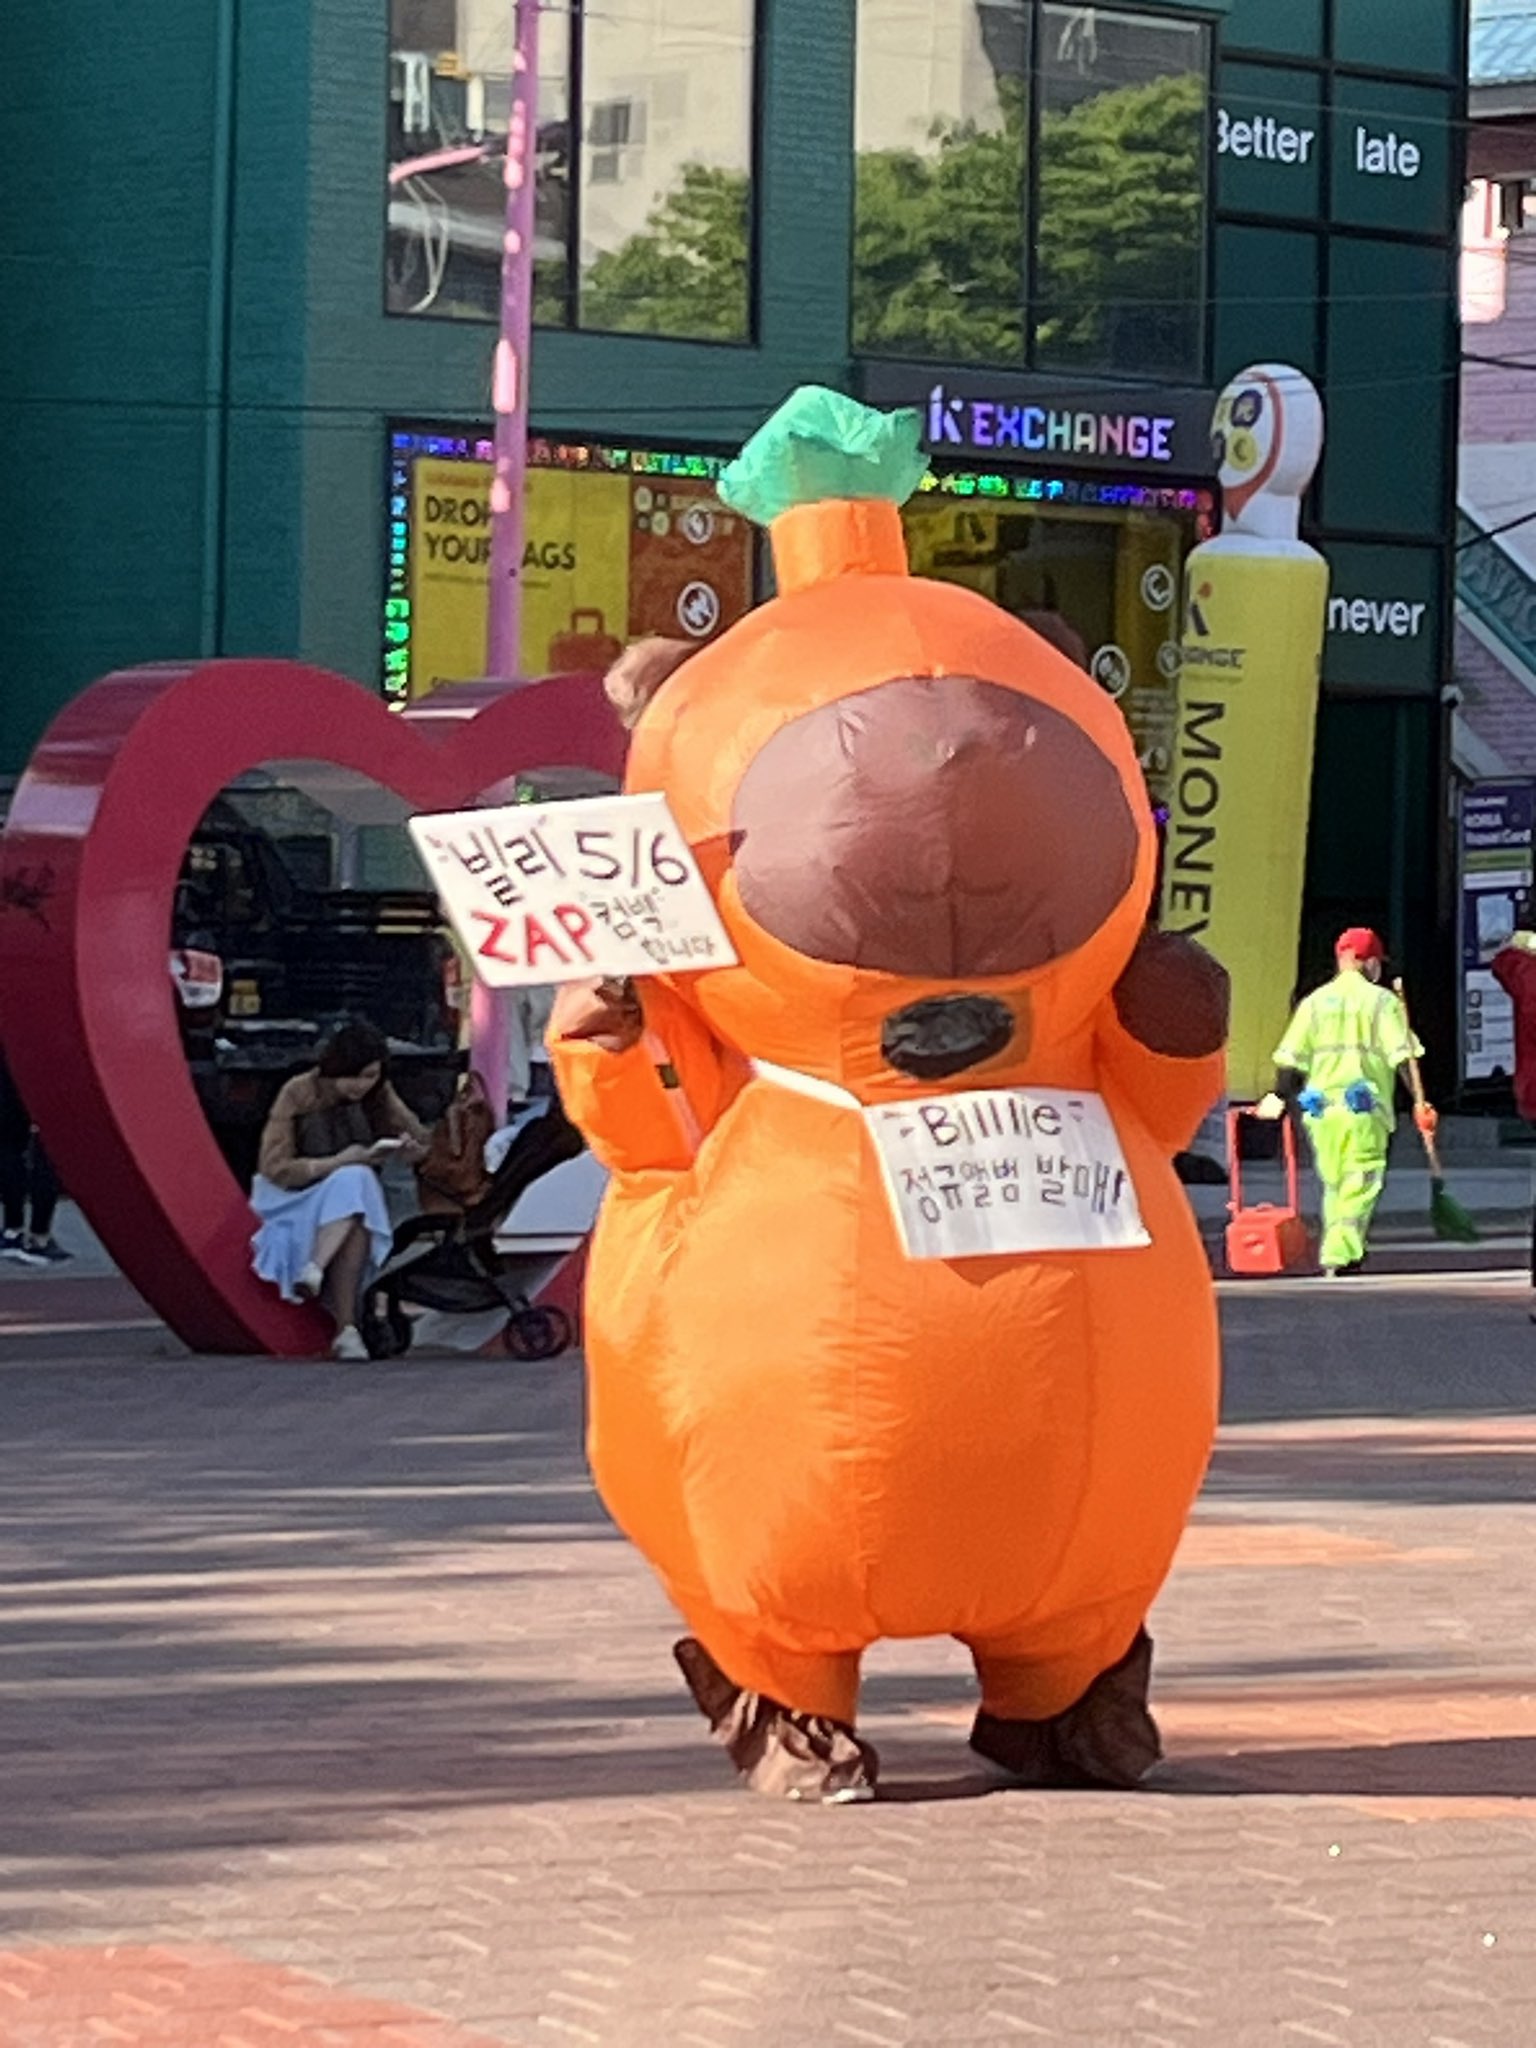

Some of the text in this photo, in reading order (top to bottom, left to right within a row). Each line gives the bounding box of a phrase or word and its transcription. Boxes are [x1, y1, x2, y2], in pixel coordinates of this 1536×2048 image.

[1357, 125, 1420, 177] late
[970, 401, 1175, 461] EXCHANGE
[521, 541, 577, 571] AGS
[1328, 597, 1426, 637] never
[574, 828, 689, 889] 5/6
[470, 904, 595, 967] ZAP
[901, 1155, 1127, 1223] 정규앨범 발매!
